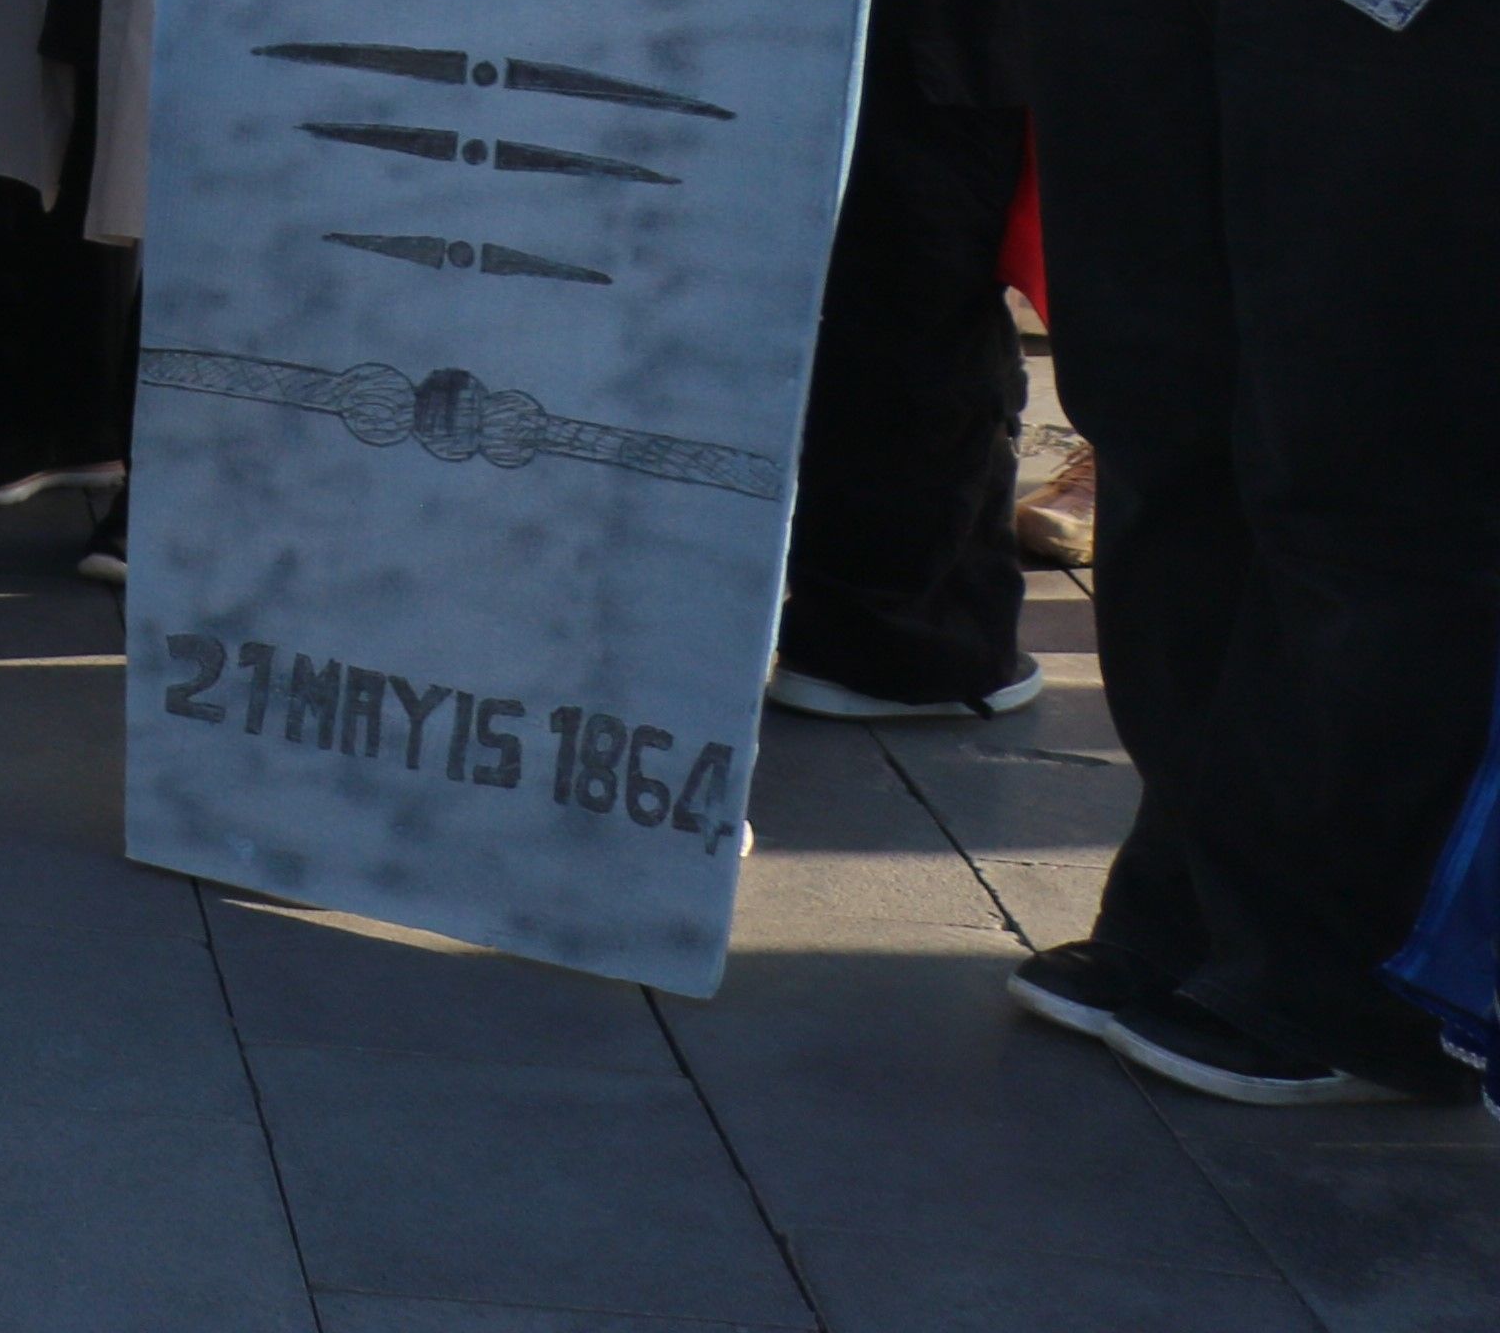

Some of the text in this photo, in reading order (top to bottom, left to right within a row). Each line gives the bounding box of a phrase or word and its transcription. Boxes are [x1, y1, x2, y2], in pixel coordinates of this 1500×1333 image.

[164, 633, 737, 857] 21 MAYIS 1864
